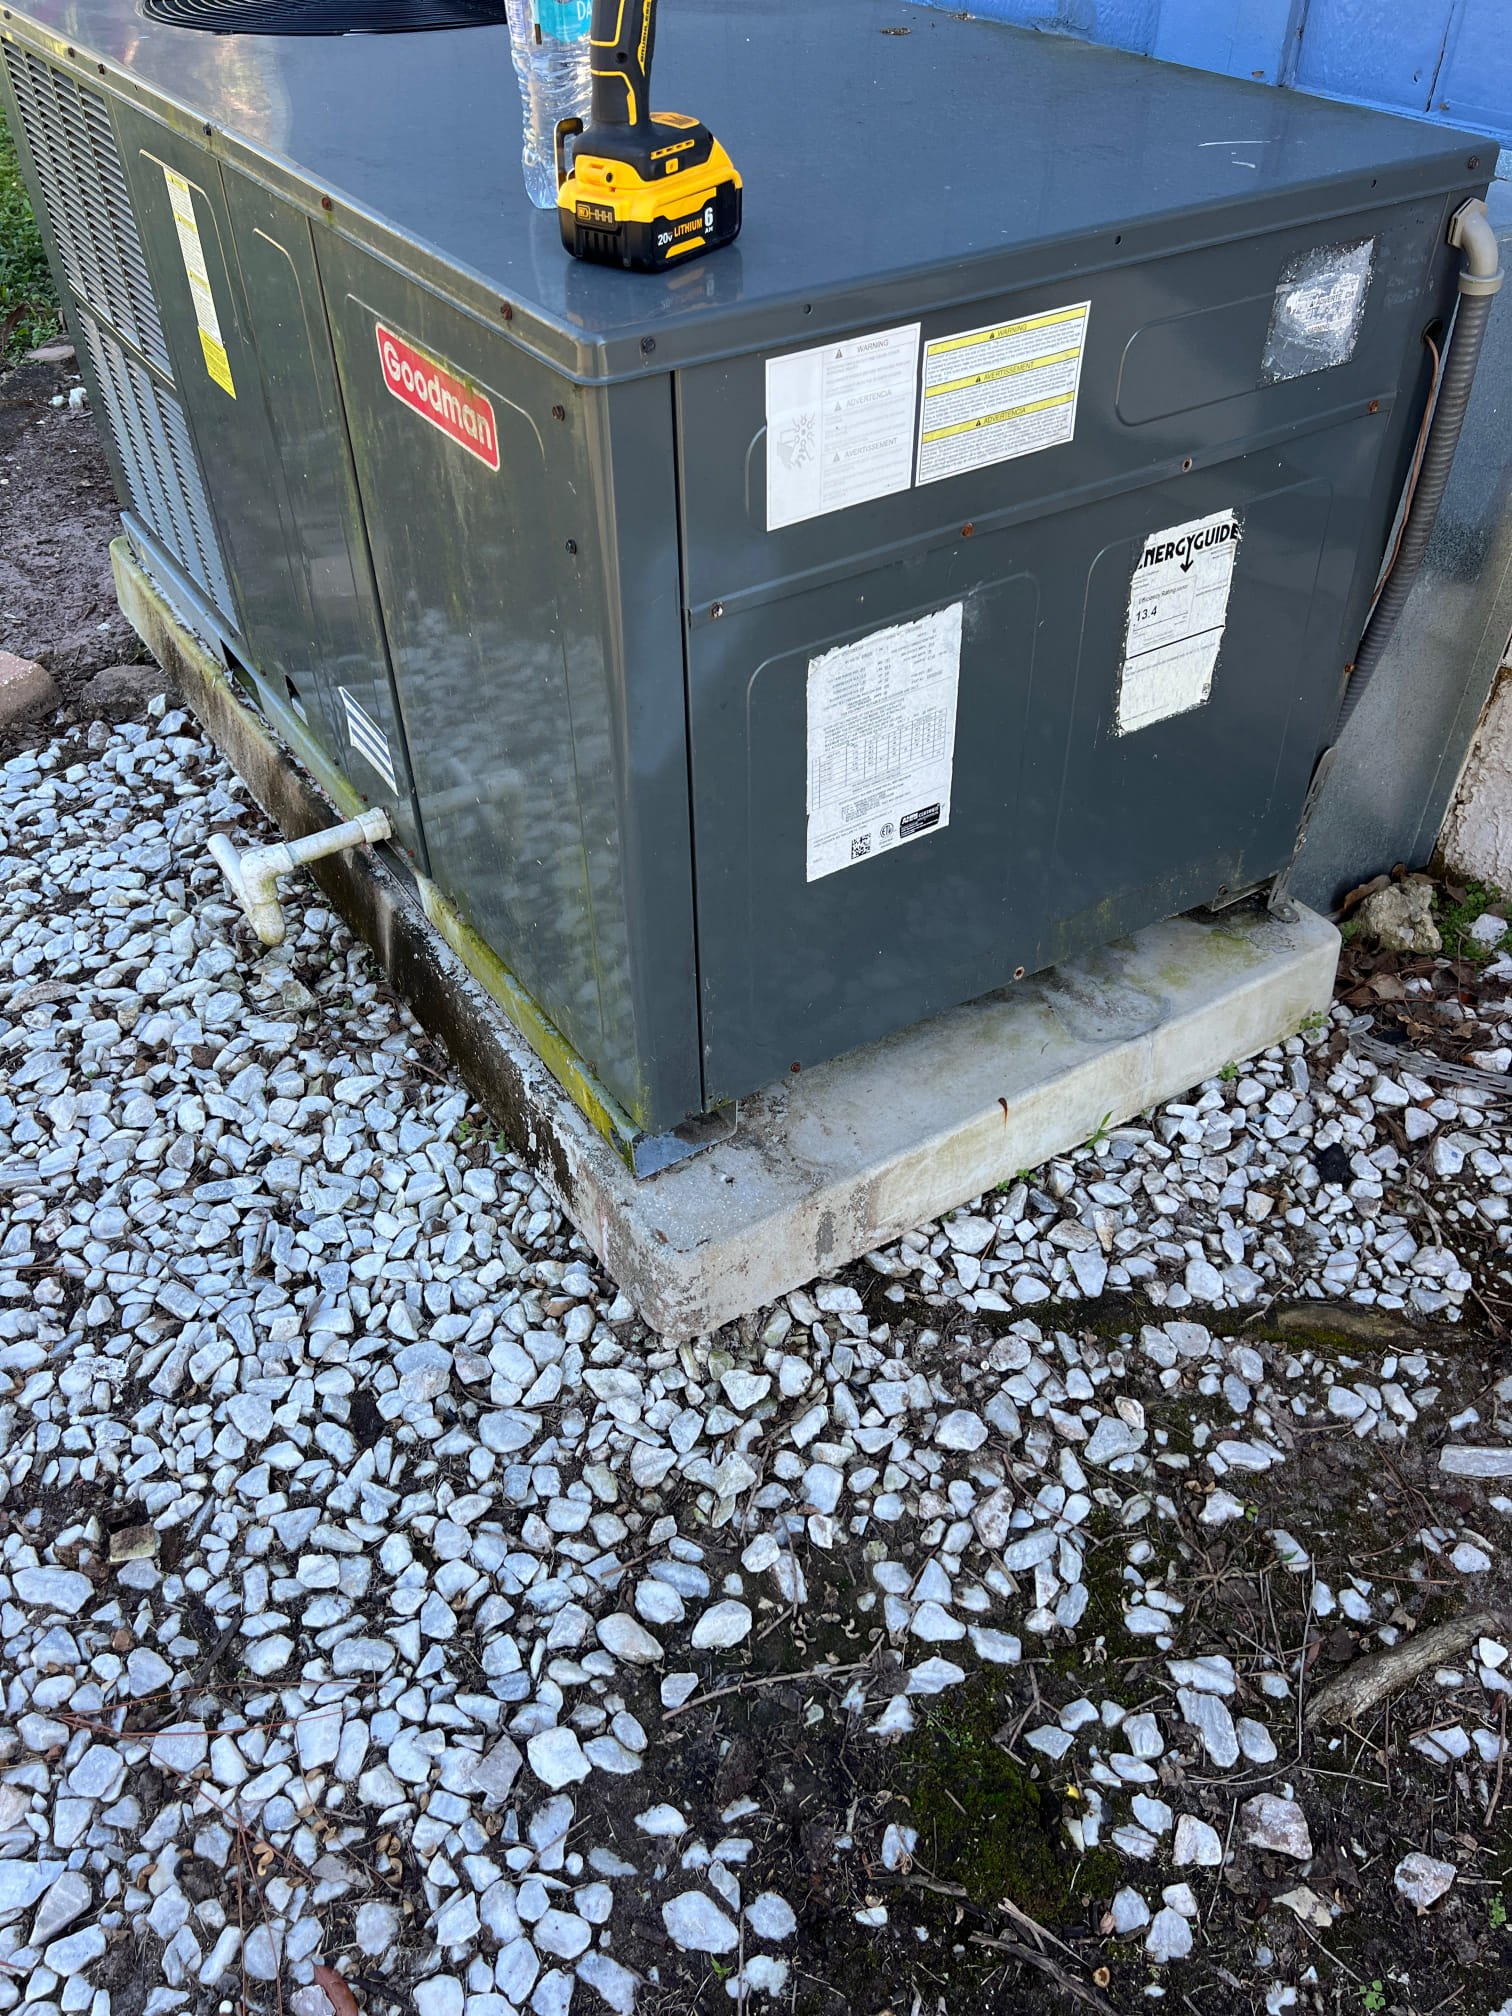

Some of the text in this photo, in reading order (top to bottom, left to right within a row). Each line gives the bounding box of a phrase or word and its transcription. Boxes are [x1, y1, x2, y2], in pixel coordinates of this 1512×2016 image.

[577, 0, 592, 21] DA
[704, 206, 714, 227] 6
[674, 217, 703, 238] LITHIUM
[997, 323, 1028, 337] WARNING
[857, 339, 889, 353] WARNING
[983, 361, 1035, 380] AVERTISSEMENT
[383, 340, 493, 451] Goodman
[983, 407, 1027, 425] ADVERTENCIA
[1138, 522, 1239, 572] NERGYGUIDE
[1136, 605, 1158, 622] 13.4
